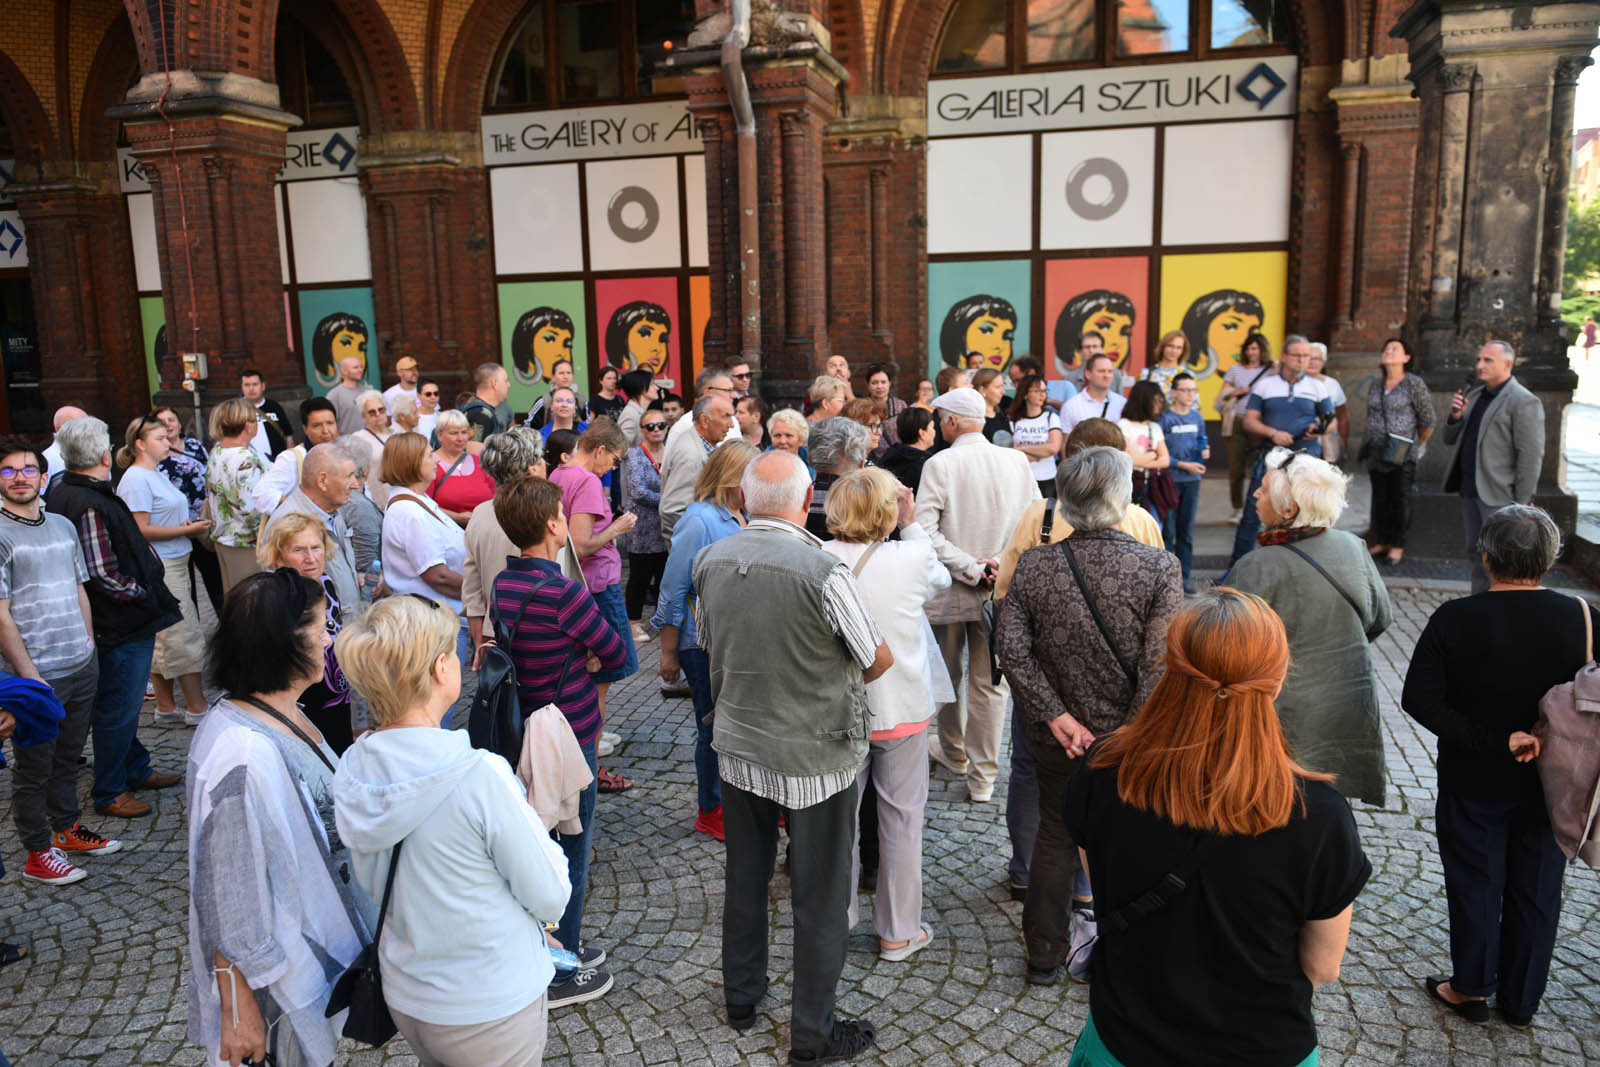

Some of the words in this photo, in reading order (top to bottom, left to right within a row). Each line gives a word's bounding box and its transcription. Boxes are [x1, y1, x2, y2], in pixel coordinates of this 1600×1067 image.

[936, 84, 1085, 121] GALERIA
[1096, 75, 1231, 112] SZTUKI
[490, 133, 516, 153] THE
[521, 117, 628, 150] GALLERY
[632, 122, 660, 143] OF
[283, 143, 322, 168] RIE
